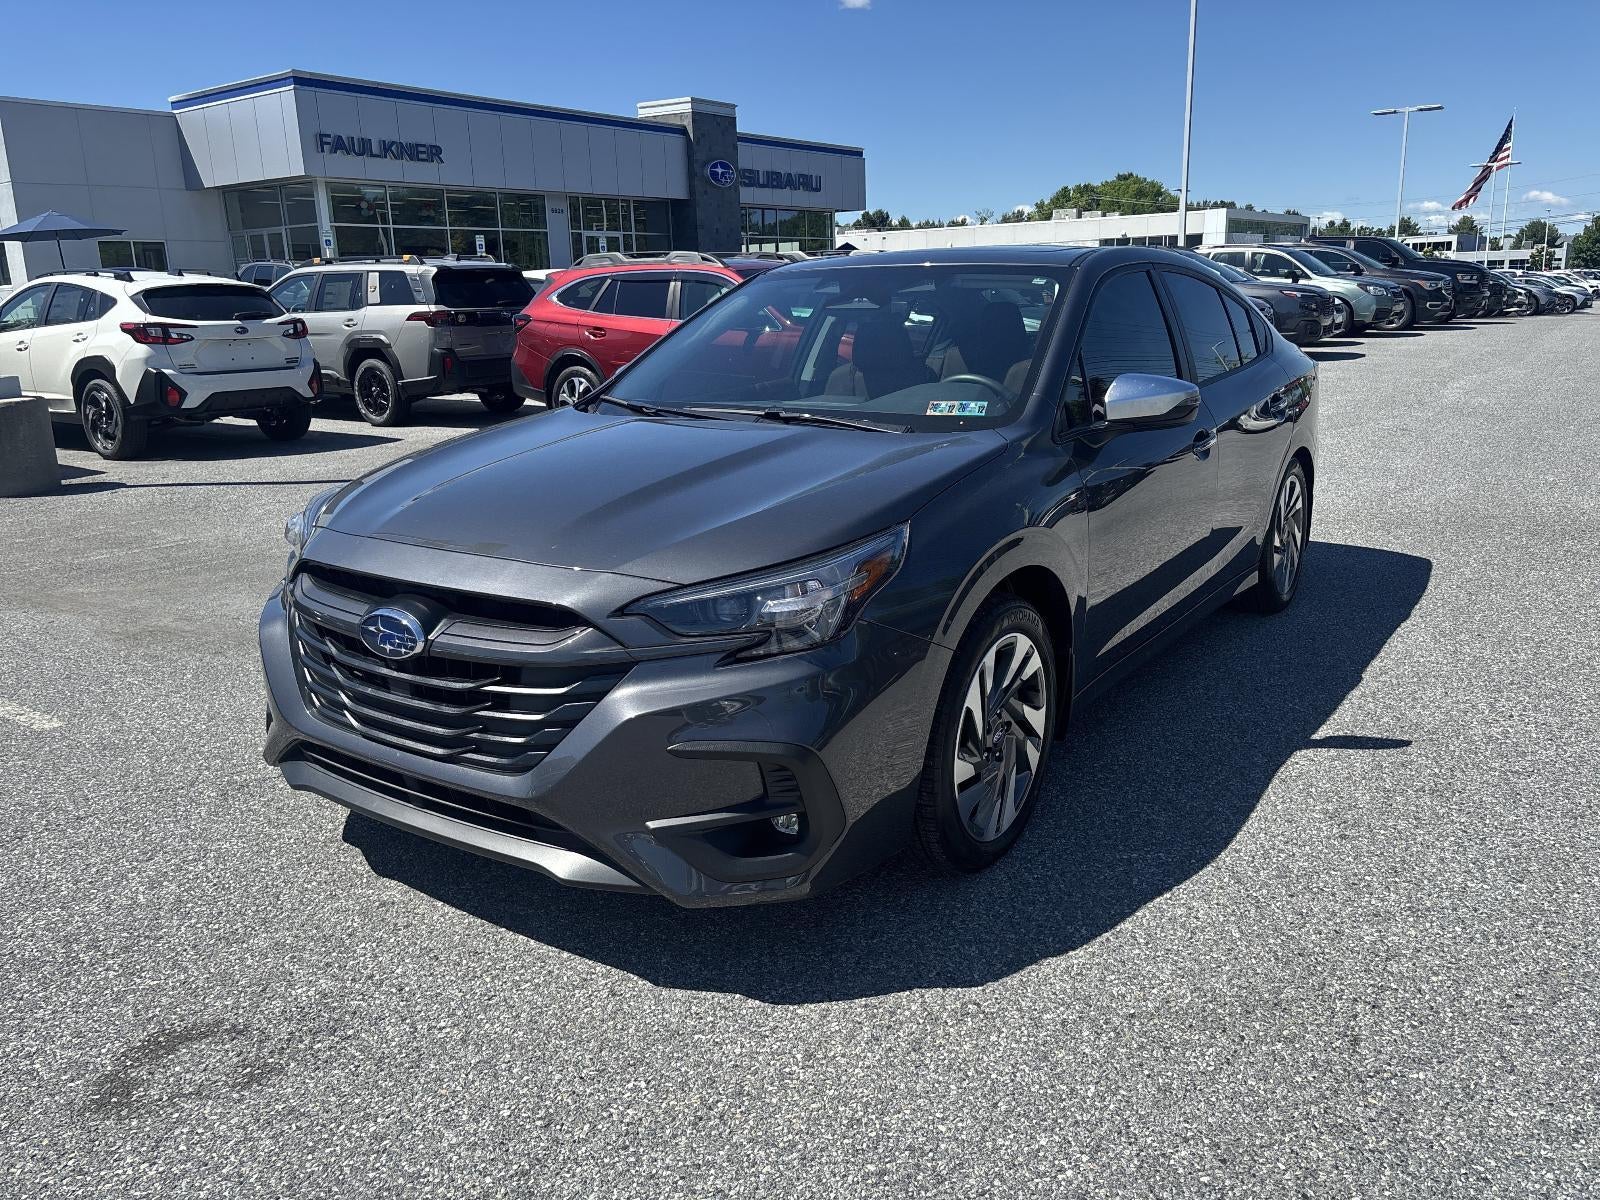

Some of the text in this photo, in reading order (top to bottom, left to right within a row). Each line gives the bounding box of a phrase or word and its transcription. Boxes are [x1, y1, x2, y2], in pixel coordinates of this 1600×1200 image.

[316, 133, 445, 164] FAULKNER
[739, 167, 822, 193] SUBARU
[947, 405, 956, 413] 12
